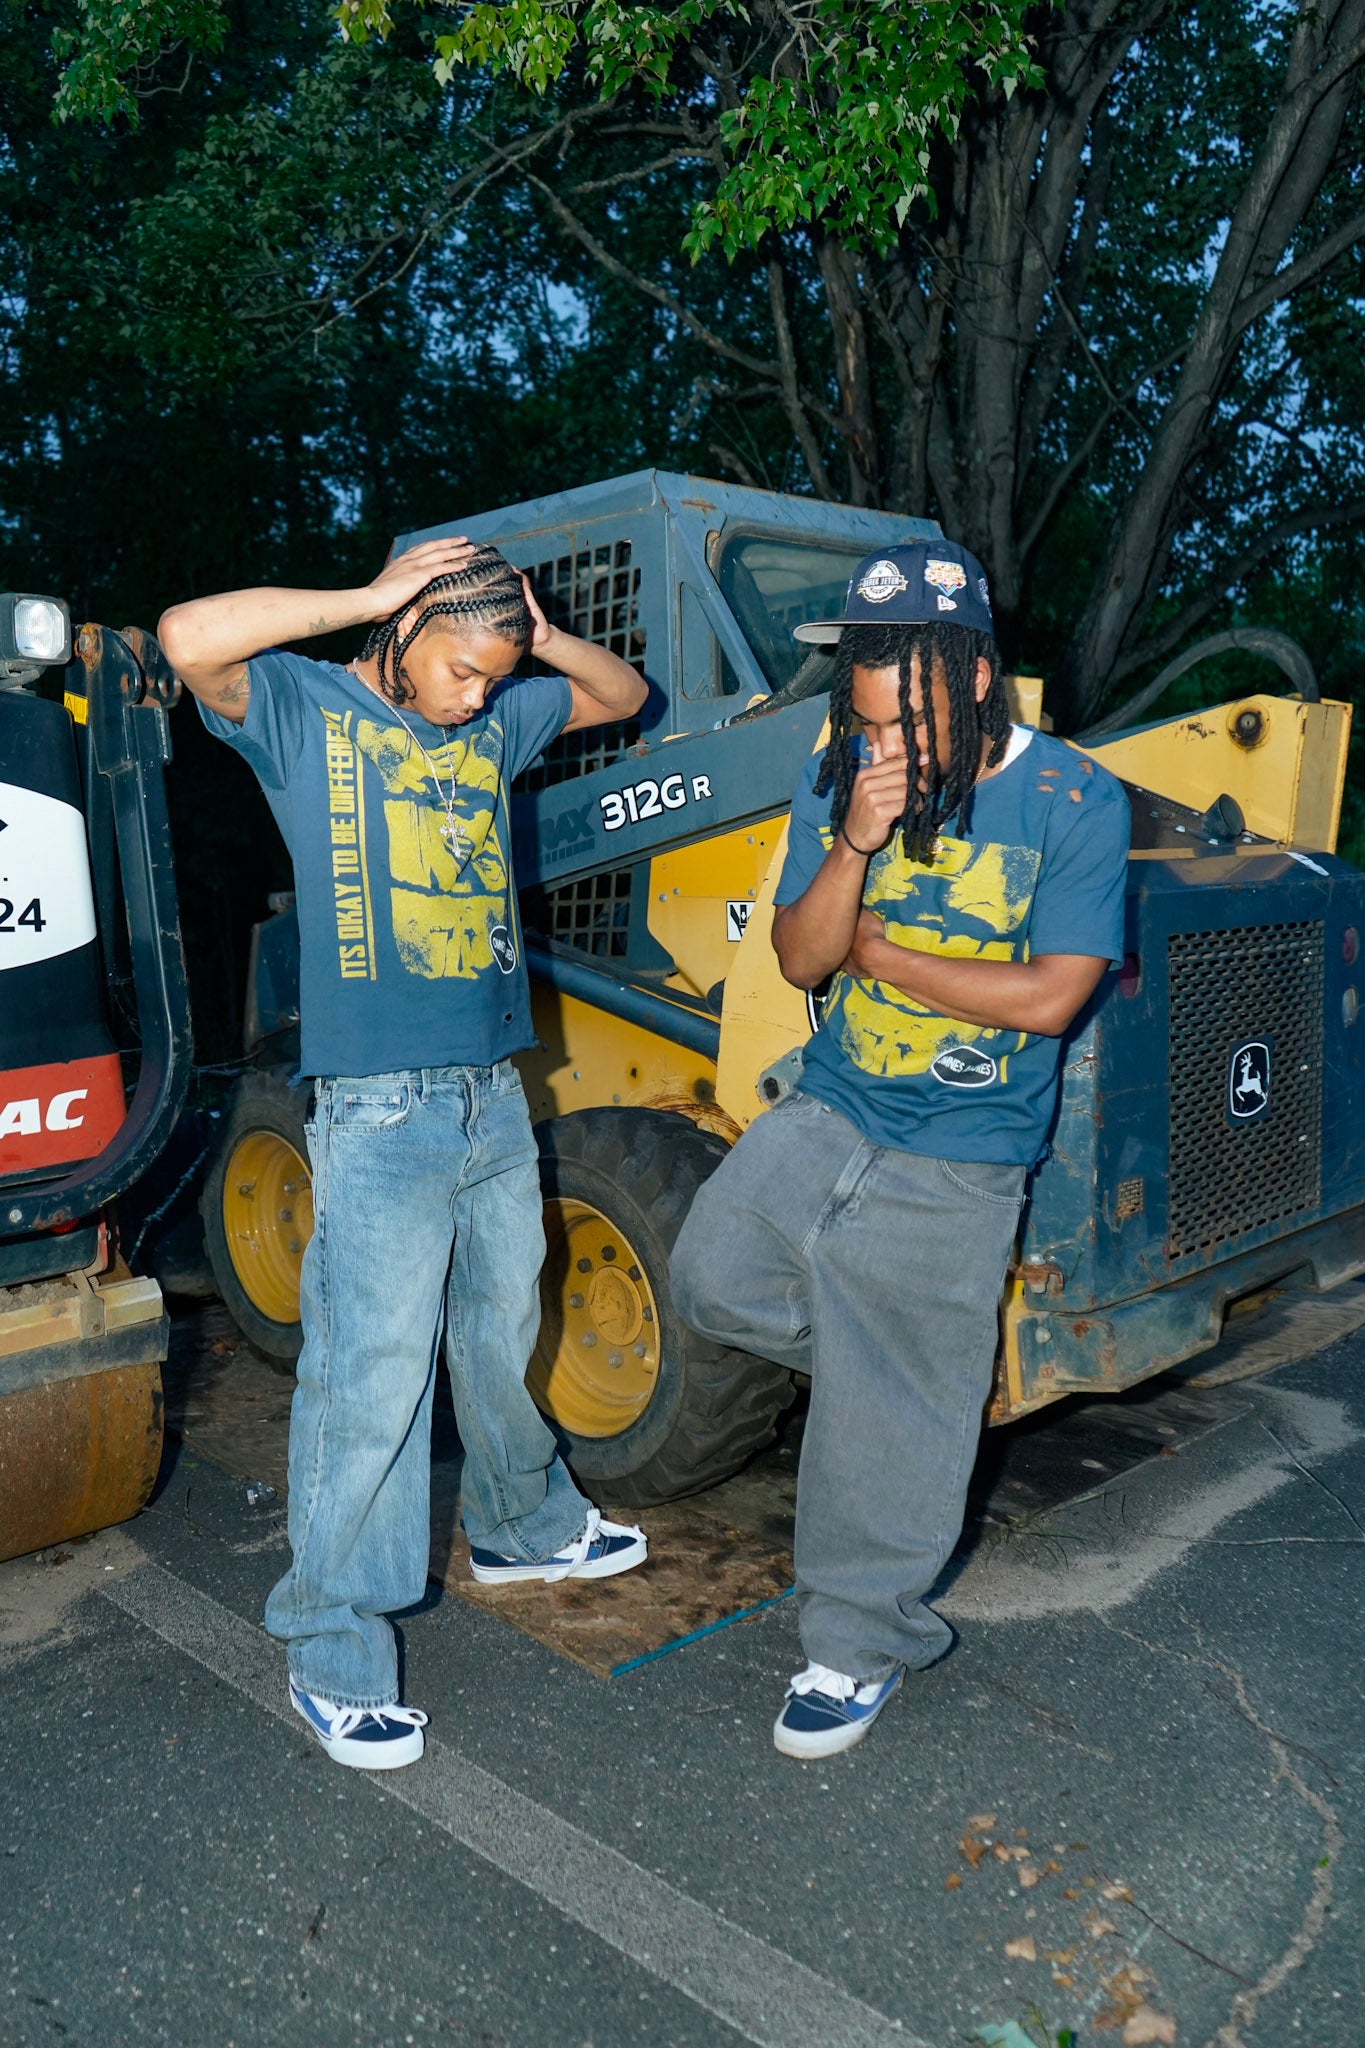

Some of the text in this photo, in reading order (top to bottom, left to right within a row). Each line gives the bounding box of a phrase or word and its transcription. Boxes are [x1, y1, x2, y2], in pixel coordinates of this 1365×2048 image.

[862, 576, 899, 587] DEREK JETER
[600, 773, 713, 831] 312G R
[330, 818, 356, 845] BE
[332, 851, 360, 878] TO
[335, 883, 363, 938] OKAY
[339, 947, 368, 979] ITS
